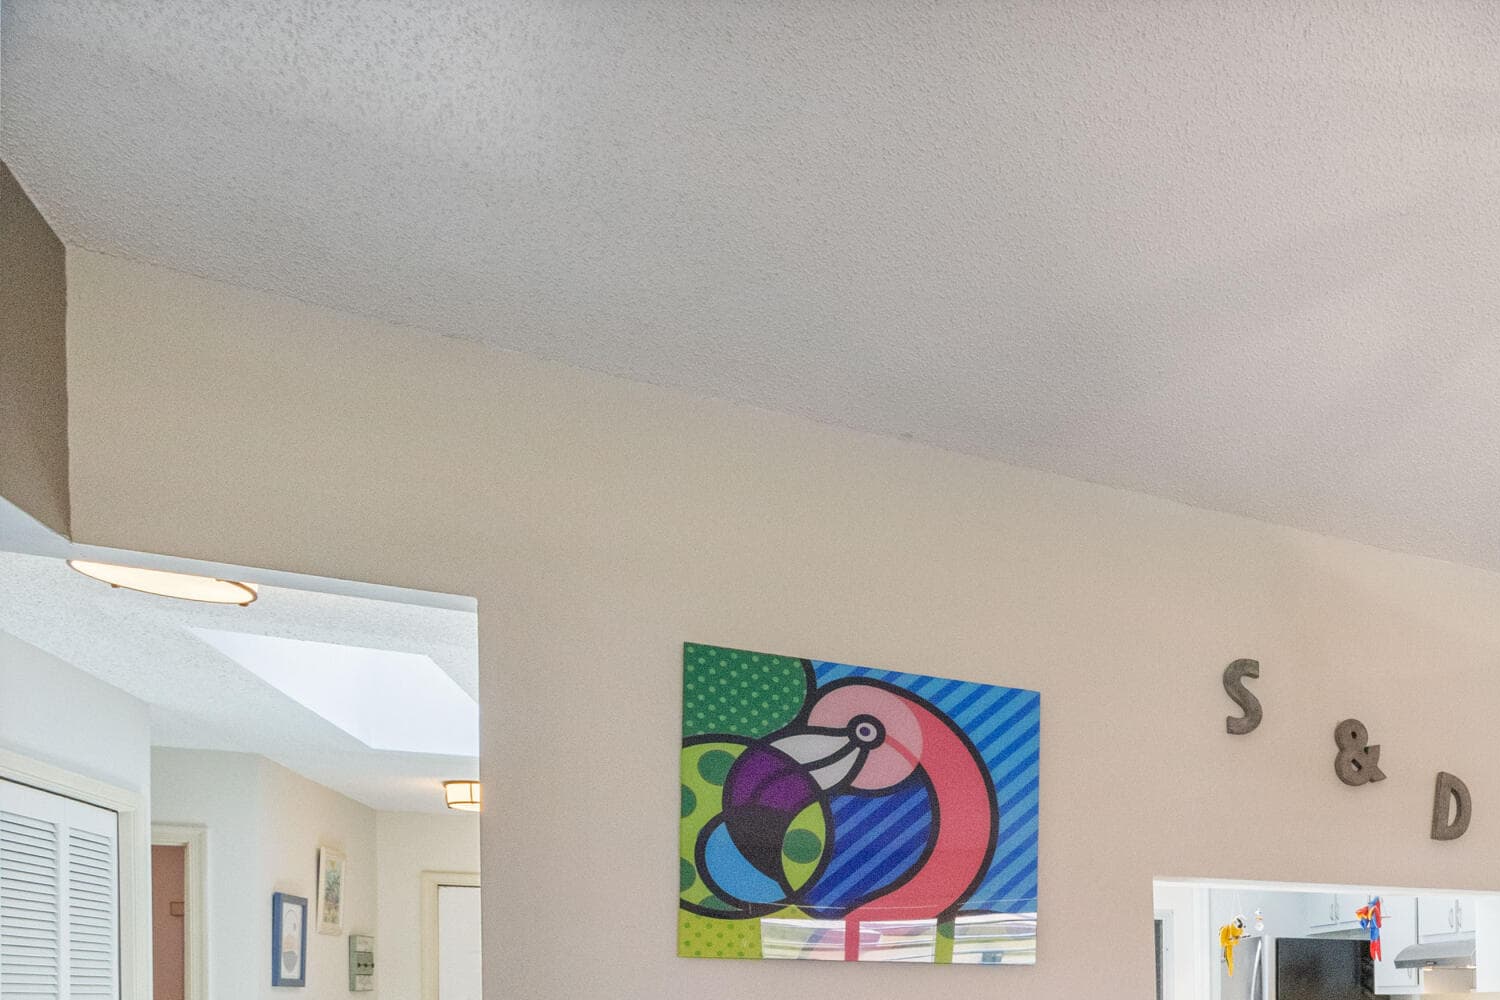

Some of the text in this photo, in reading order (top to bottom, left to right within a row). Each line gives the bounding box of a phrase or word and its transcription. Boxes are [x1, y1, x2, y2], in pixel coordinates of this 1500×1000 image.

[1222, 658, 1472, 841] S & D
